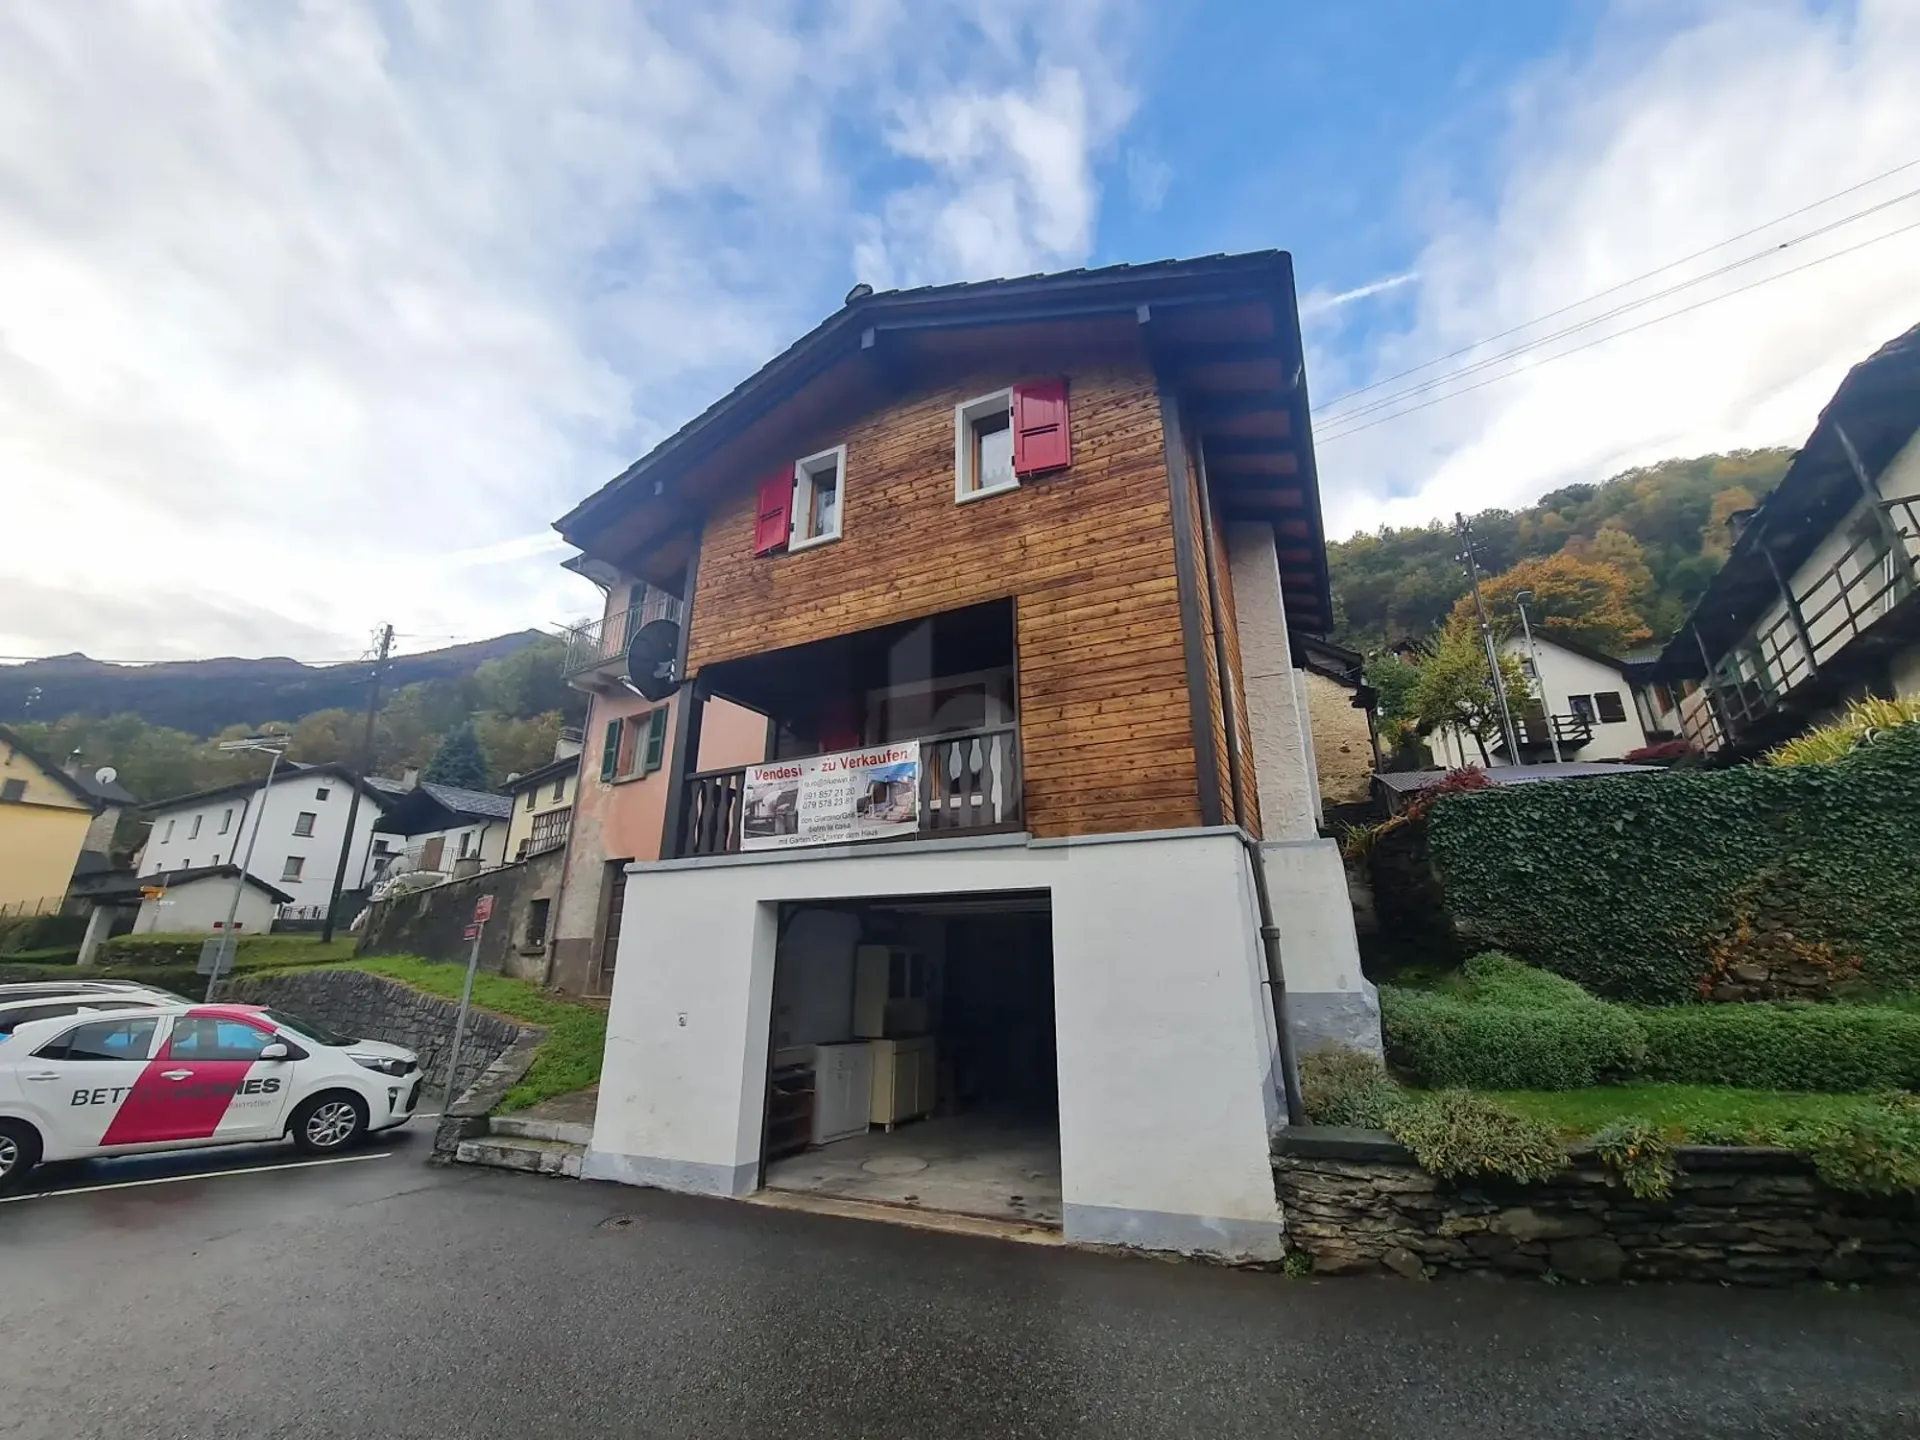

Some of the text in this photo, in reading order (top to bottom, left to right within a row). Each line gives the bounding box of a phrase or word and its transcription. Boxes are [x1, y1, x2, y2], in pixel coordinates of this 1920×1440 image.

[754, 763, 803, 782] Vendesi
[821, 761, 836, 773] zu
[840, 750, 908, 770] Verkaufen
[834, 788, 843, 798] 21
[834, 797, 843, 806] 23
